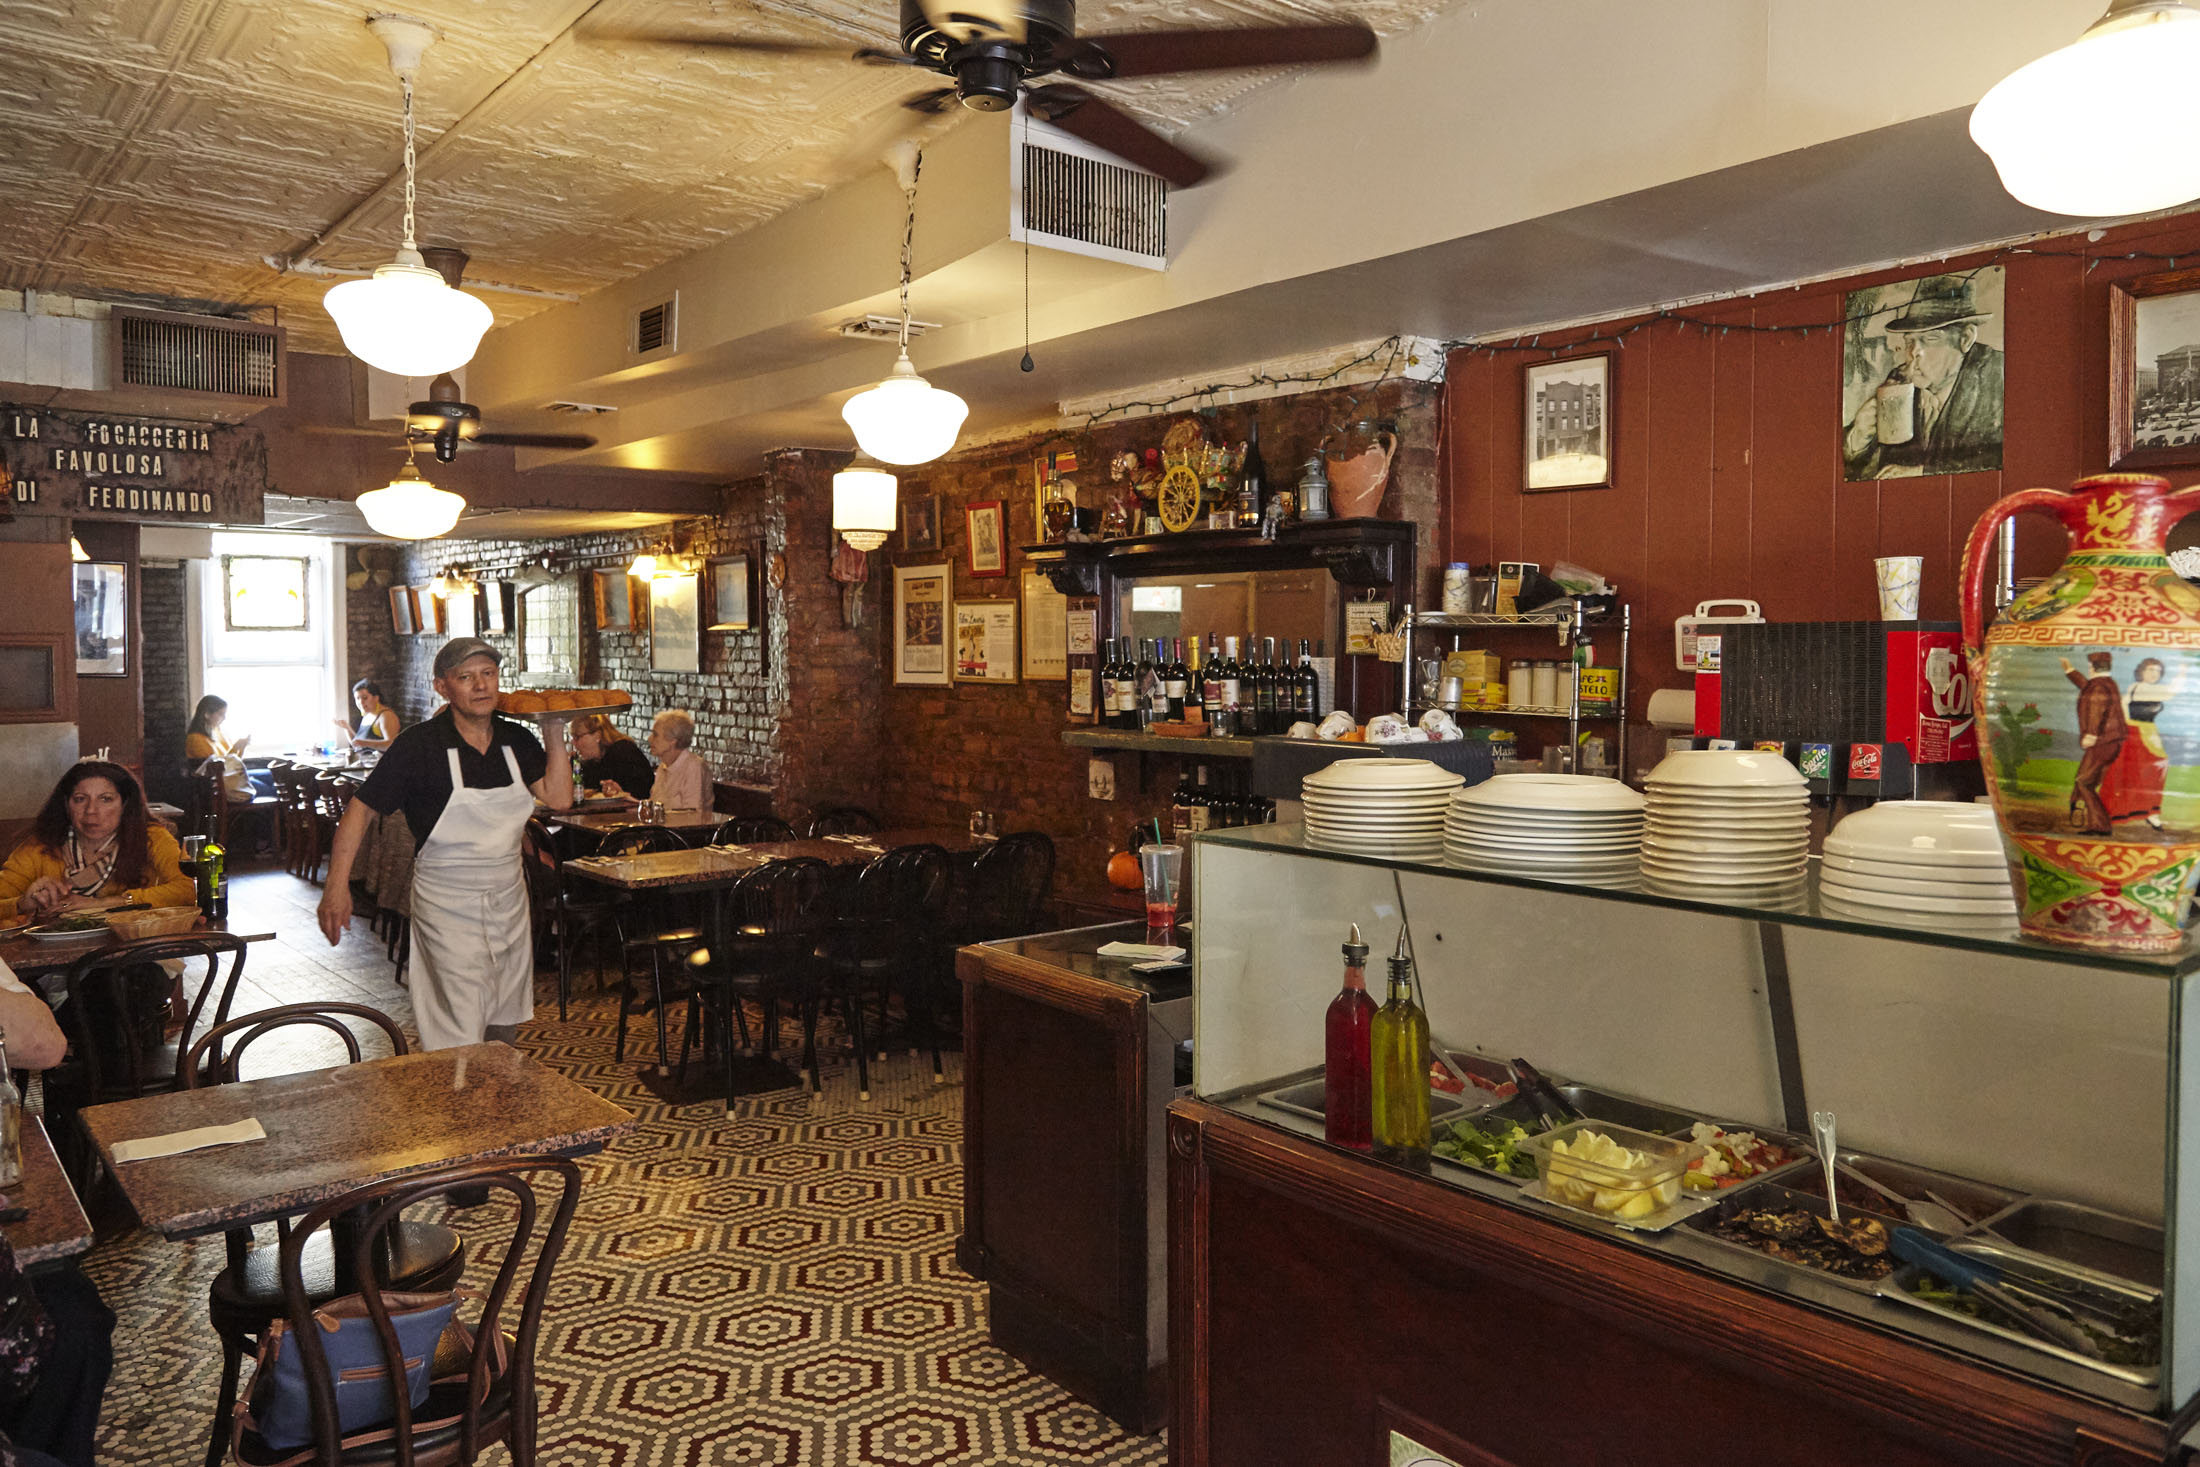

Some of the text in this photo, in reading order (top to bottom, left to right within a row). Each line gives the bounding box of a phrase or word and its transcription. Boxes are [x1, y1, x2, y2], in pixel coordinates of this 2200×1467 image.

[15, 416, 209, 451] LA FOCACCERIA
[55, 449, 163, 476] FAVOLOSA
[17, 480, 212, 513] DI FERDINANDO
[1802, 748, 1828, 774] Sprite
